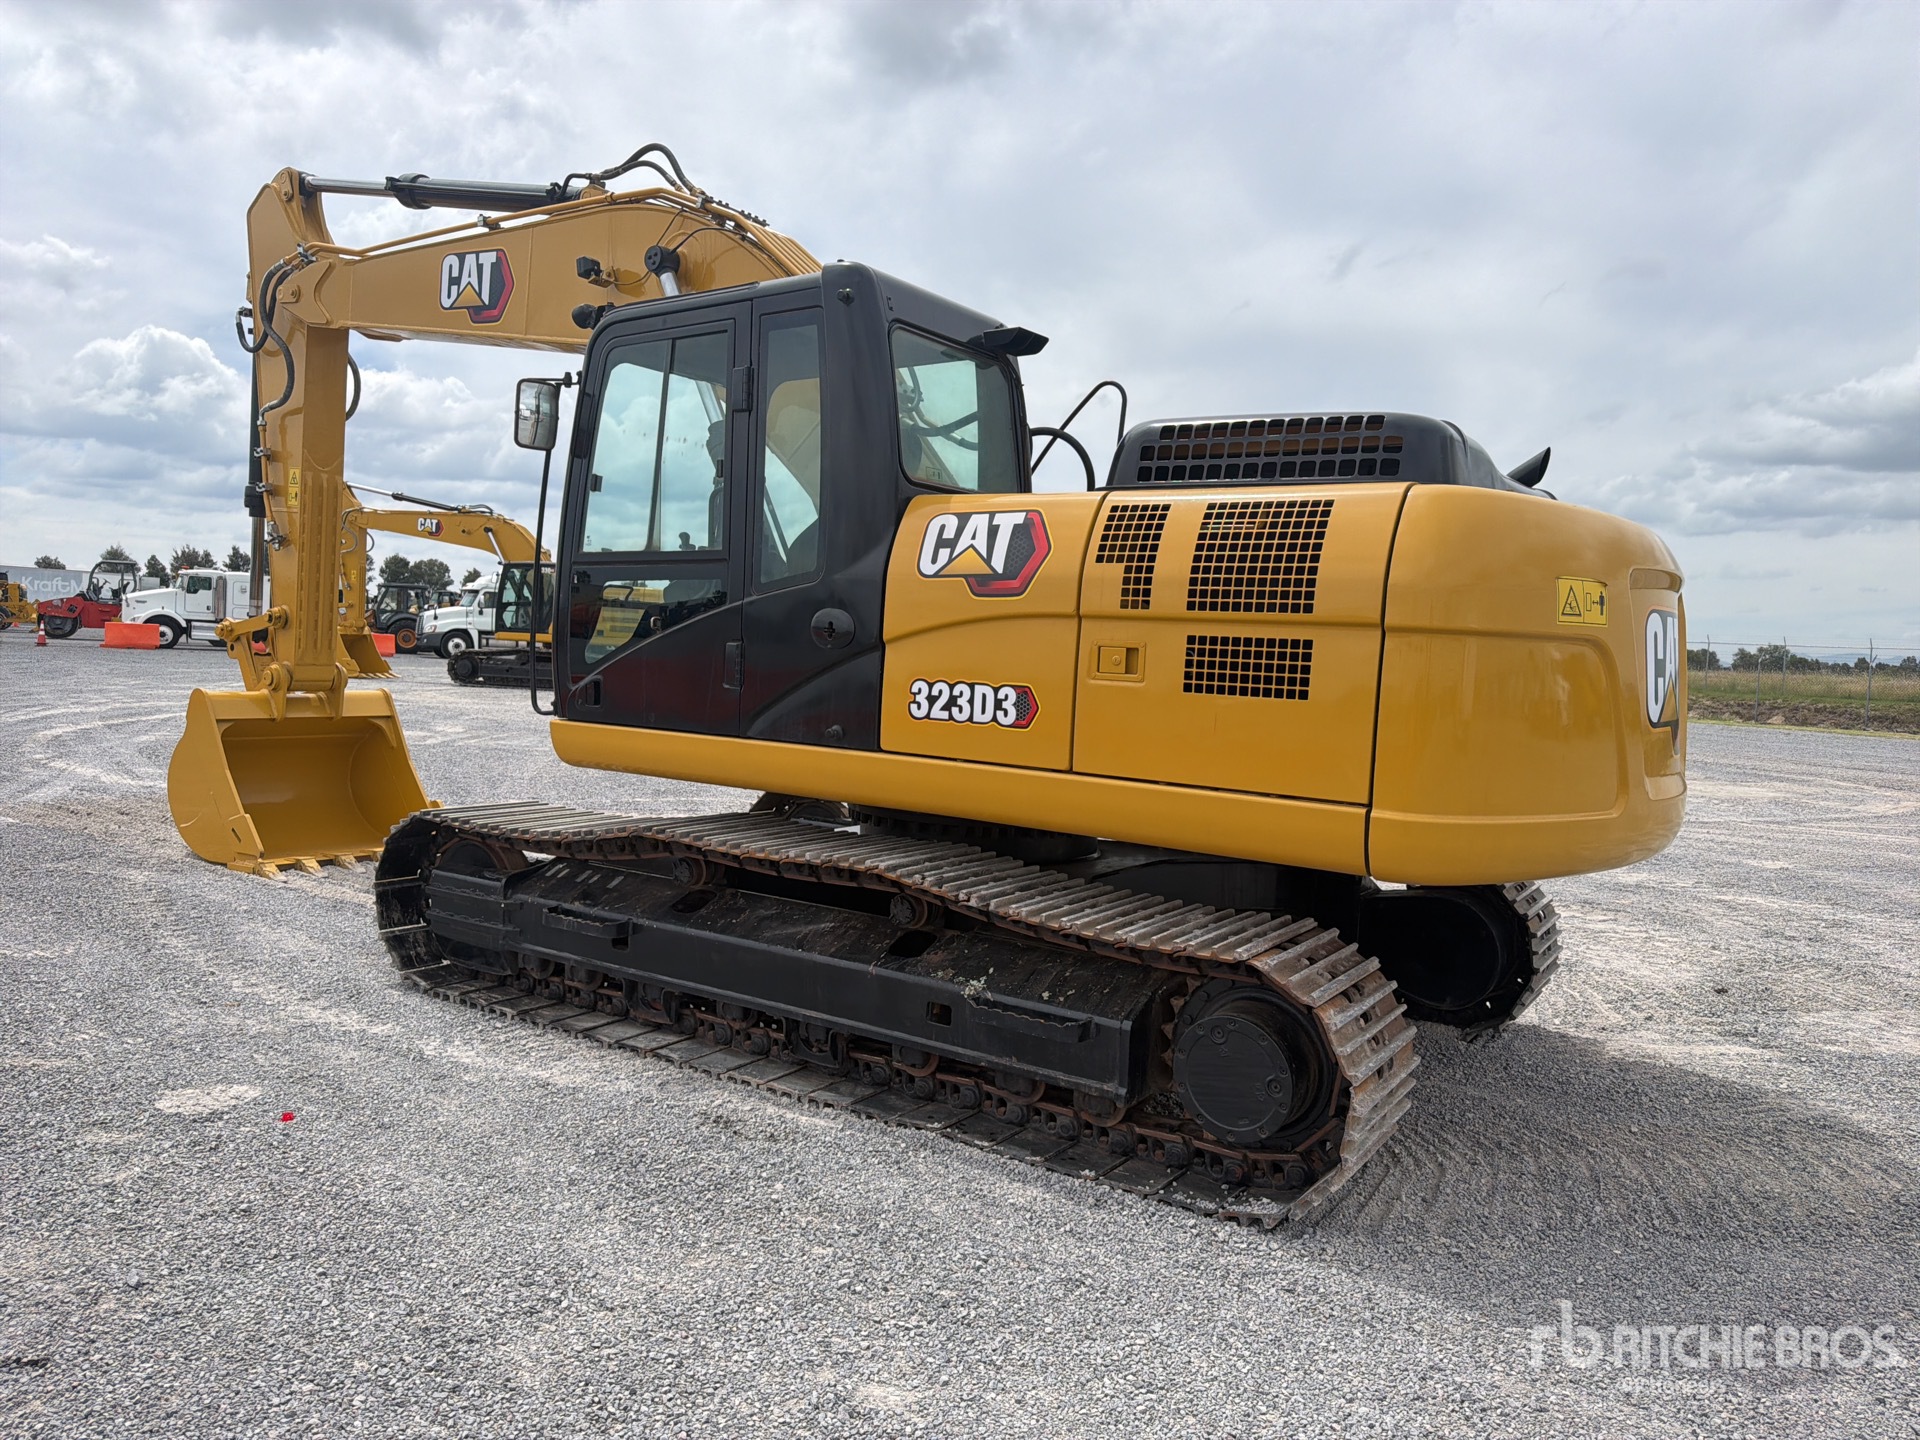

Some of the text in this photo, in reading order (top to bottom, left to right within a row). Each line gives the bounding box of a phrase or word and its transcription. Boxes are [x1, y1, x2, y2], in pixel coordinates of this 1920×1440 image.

[441, 251, 497, 308] CAT
[417, 517, 438, 532] CAT
[919, 512, 1026, 575] CAT
[909, 680, 1017, 725] 323D3
